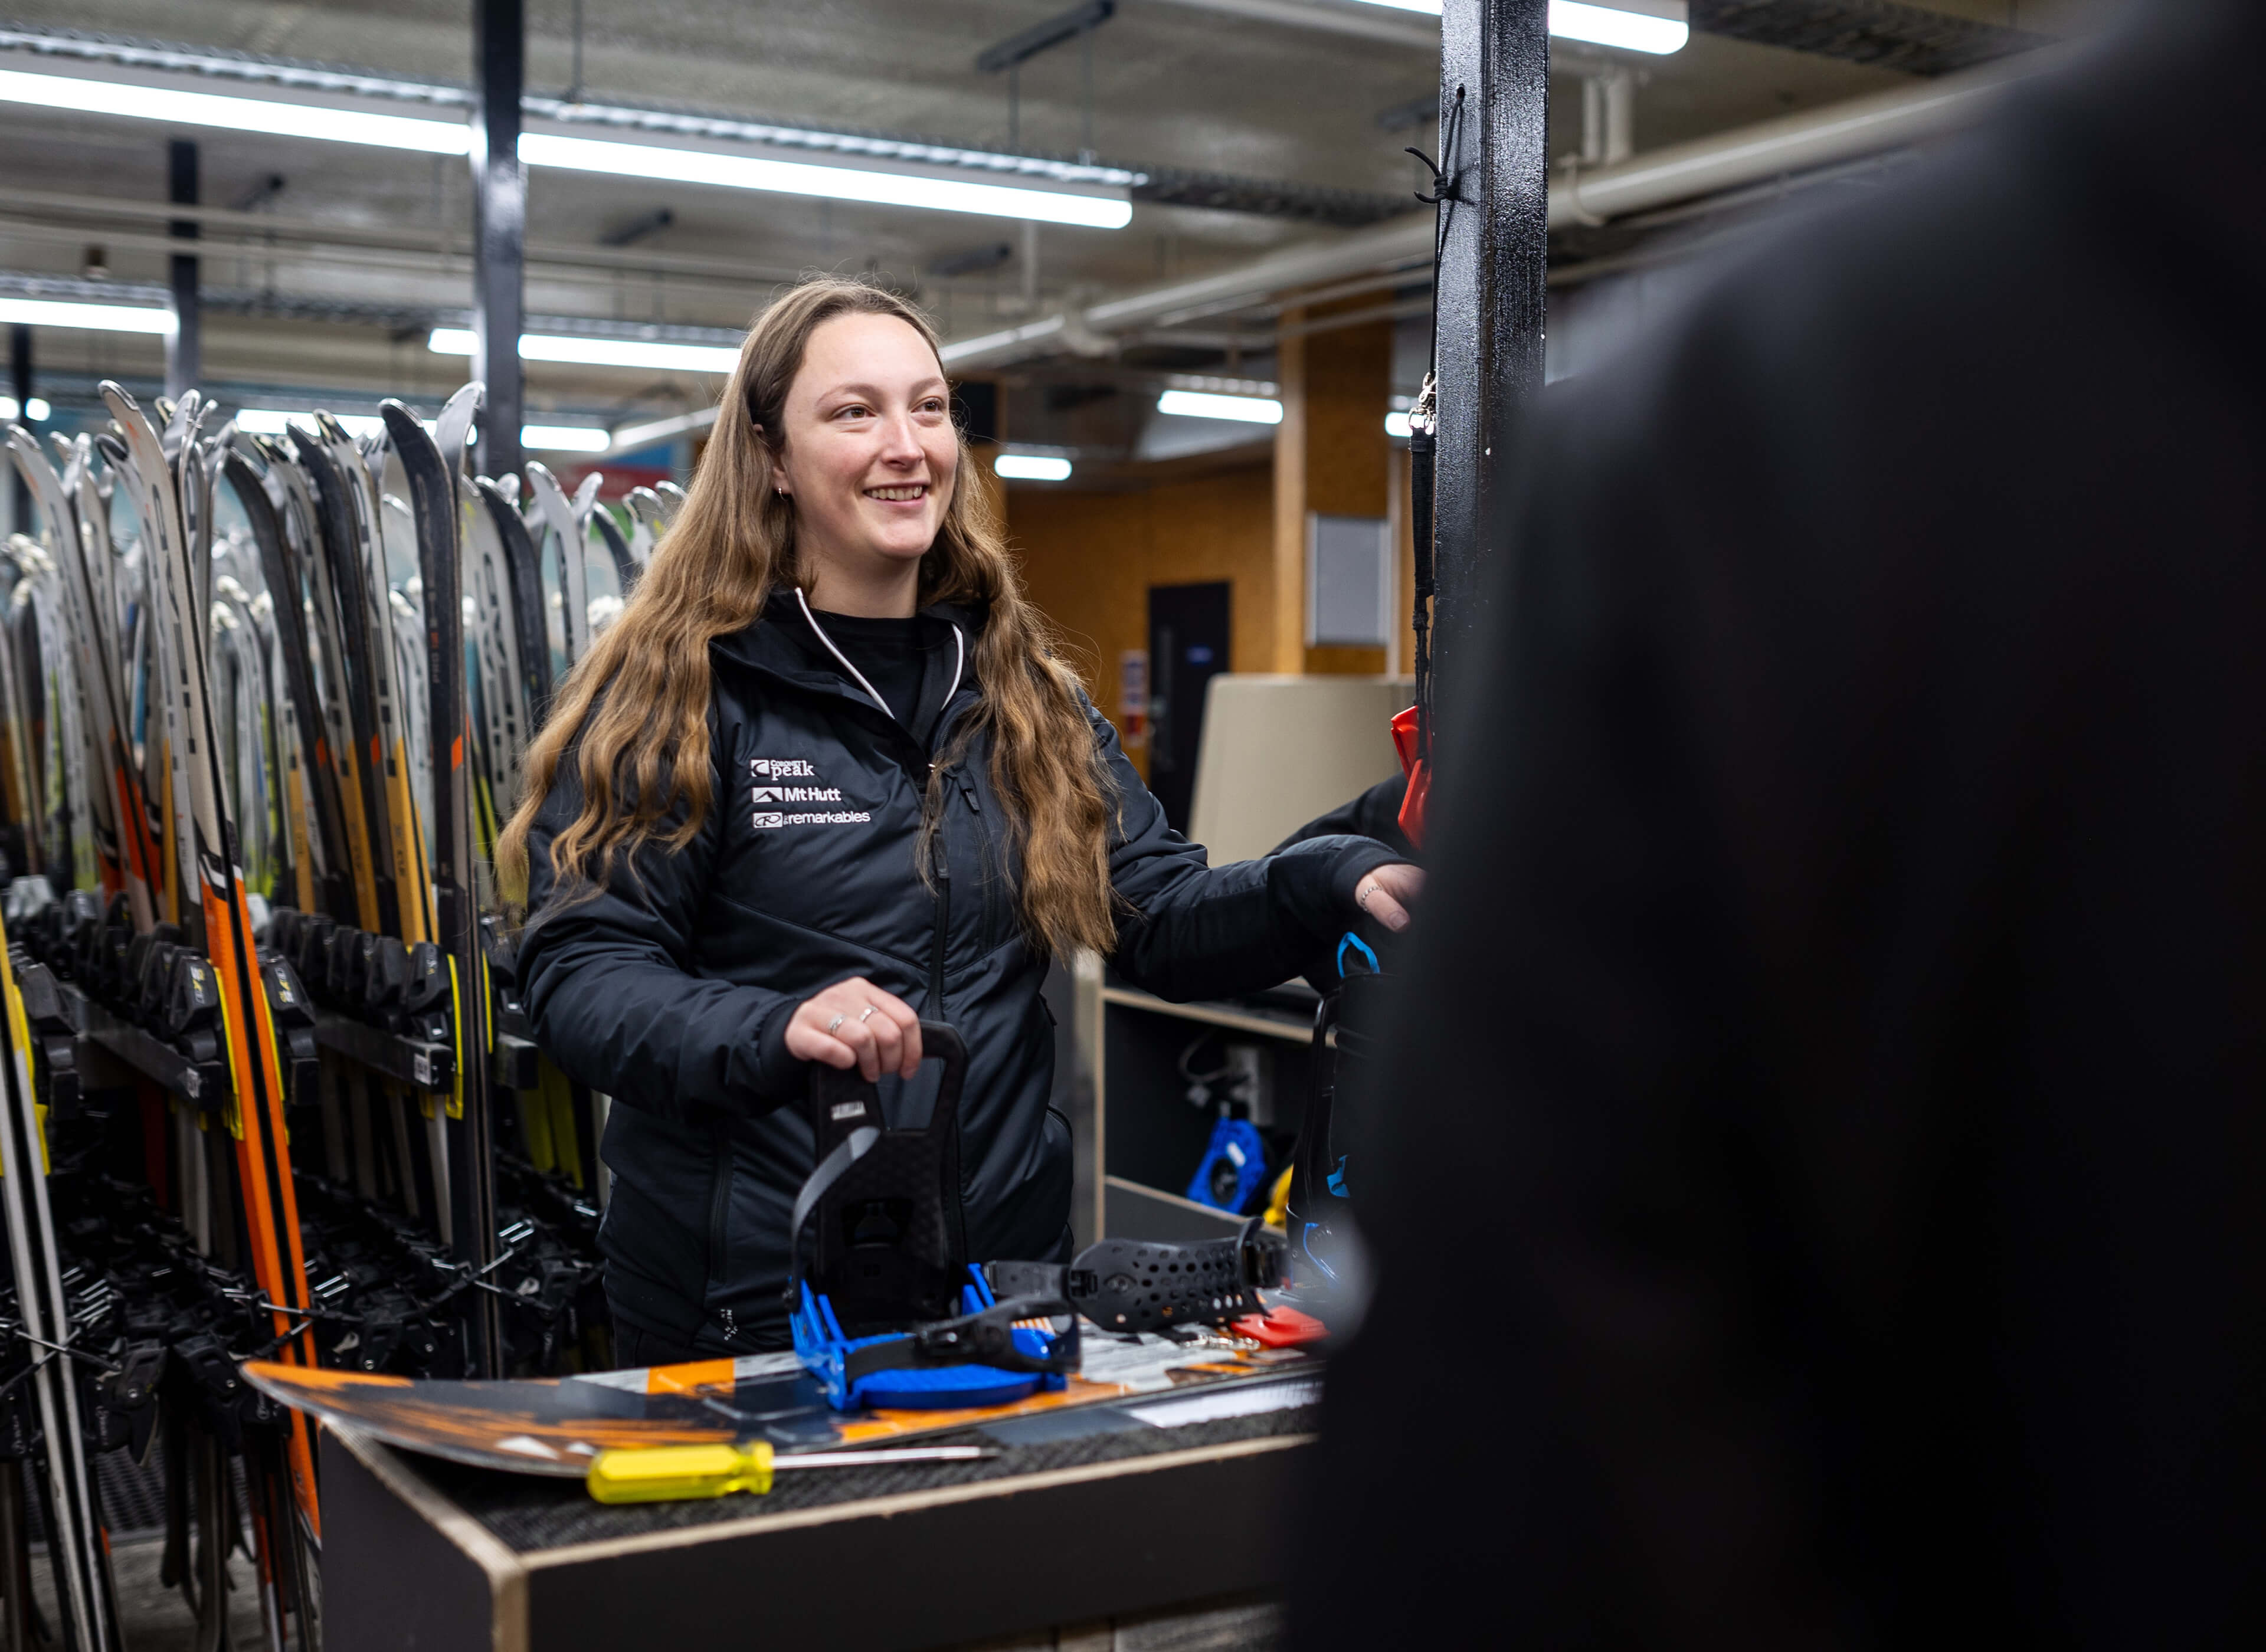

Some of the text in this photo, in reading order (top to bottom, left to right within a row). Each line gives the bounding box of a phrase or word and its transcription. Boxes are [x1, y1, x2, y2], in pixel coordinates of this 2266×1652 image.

[770, 760, 815, 781] peak
[784, 787, 841, 802] Mt Hutt
[788, 811, 871, 824] remarkables
